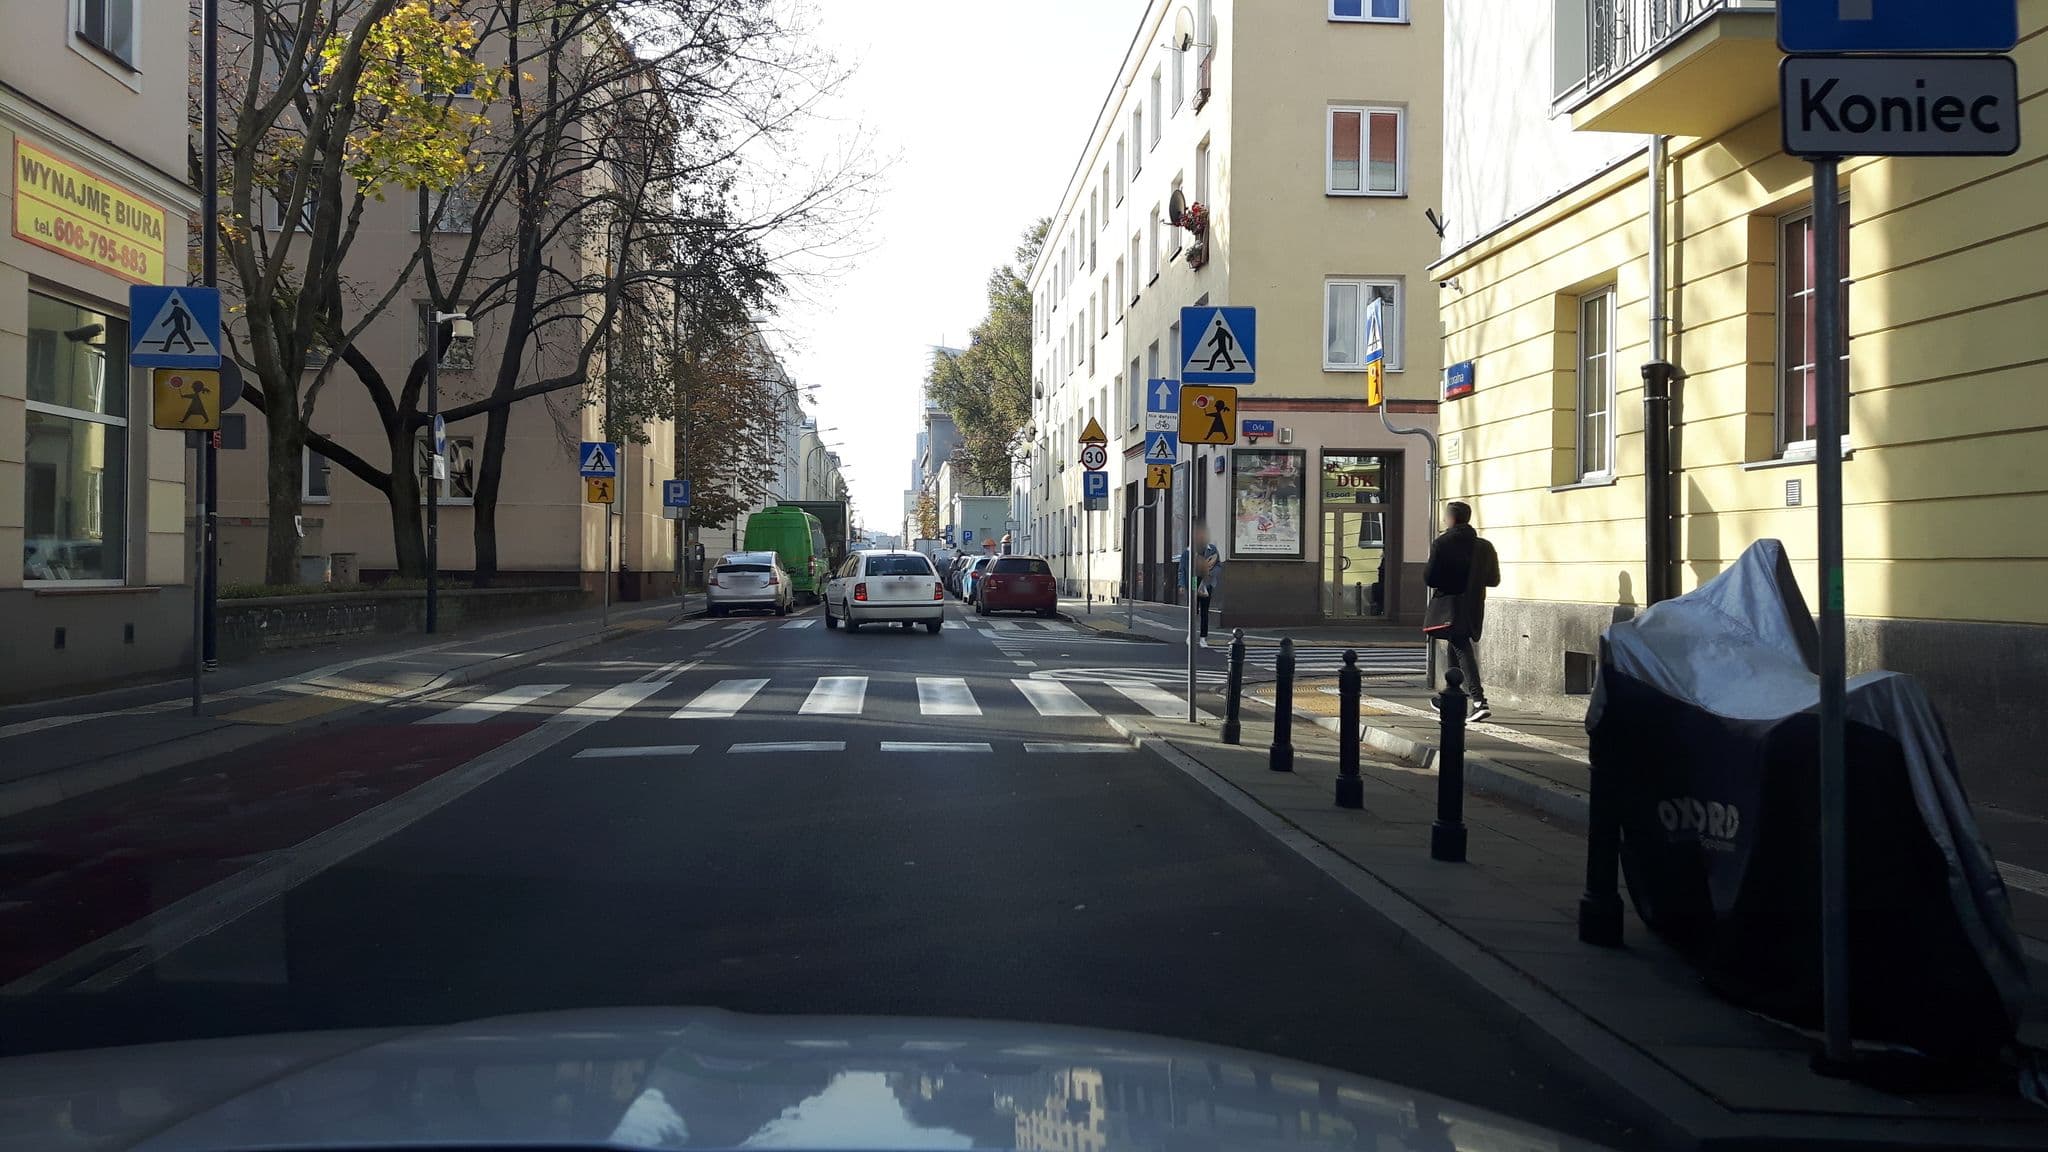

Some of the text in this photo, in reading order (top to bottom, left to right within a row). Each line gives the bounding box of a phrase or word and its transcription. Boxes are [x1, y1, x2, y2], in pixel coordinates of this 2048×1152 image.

[1801, 78, 2000, 133] Koniec
[21, 154, 162, 242] WYNAJMĘ BIURA
[34, 216, 147, 276] tel. 606-795-883
[1085, 451, 1103, 464] 30
[1088, 474, 1104, 495] P
[1337, 472, 1376, 487] DUK
[669, 482, 684, 503] P
